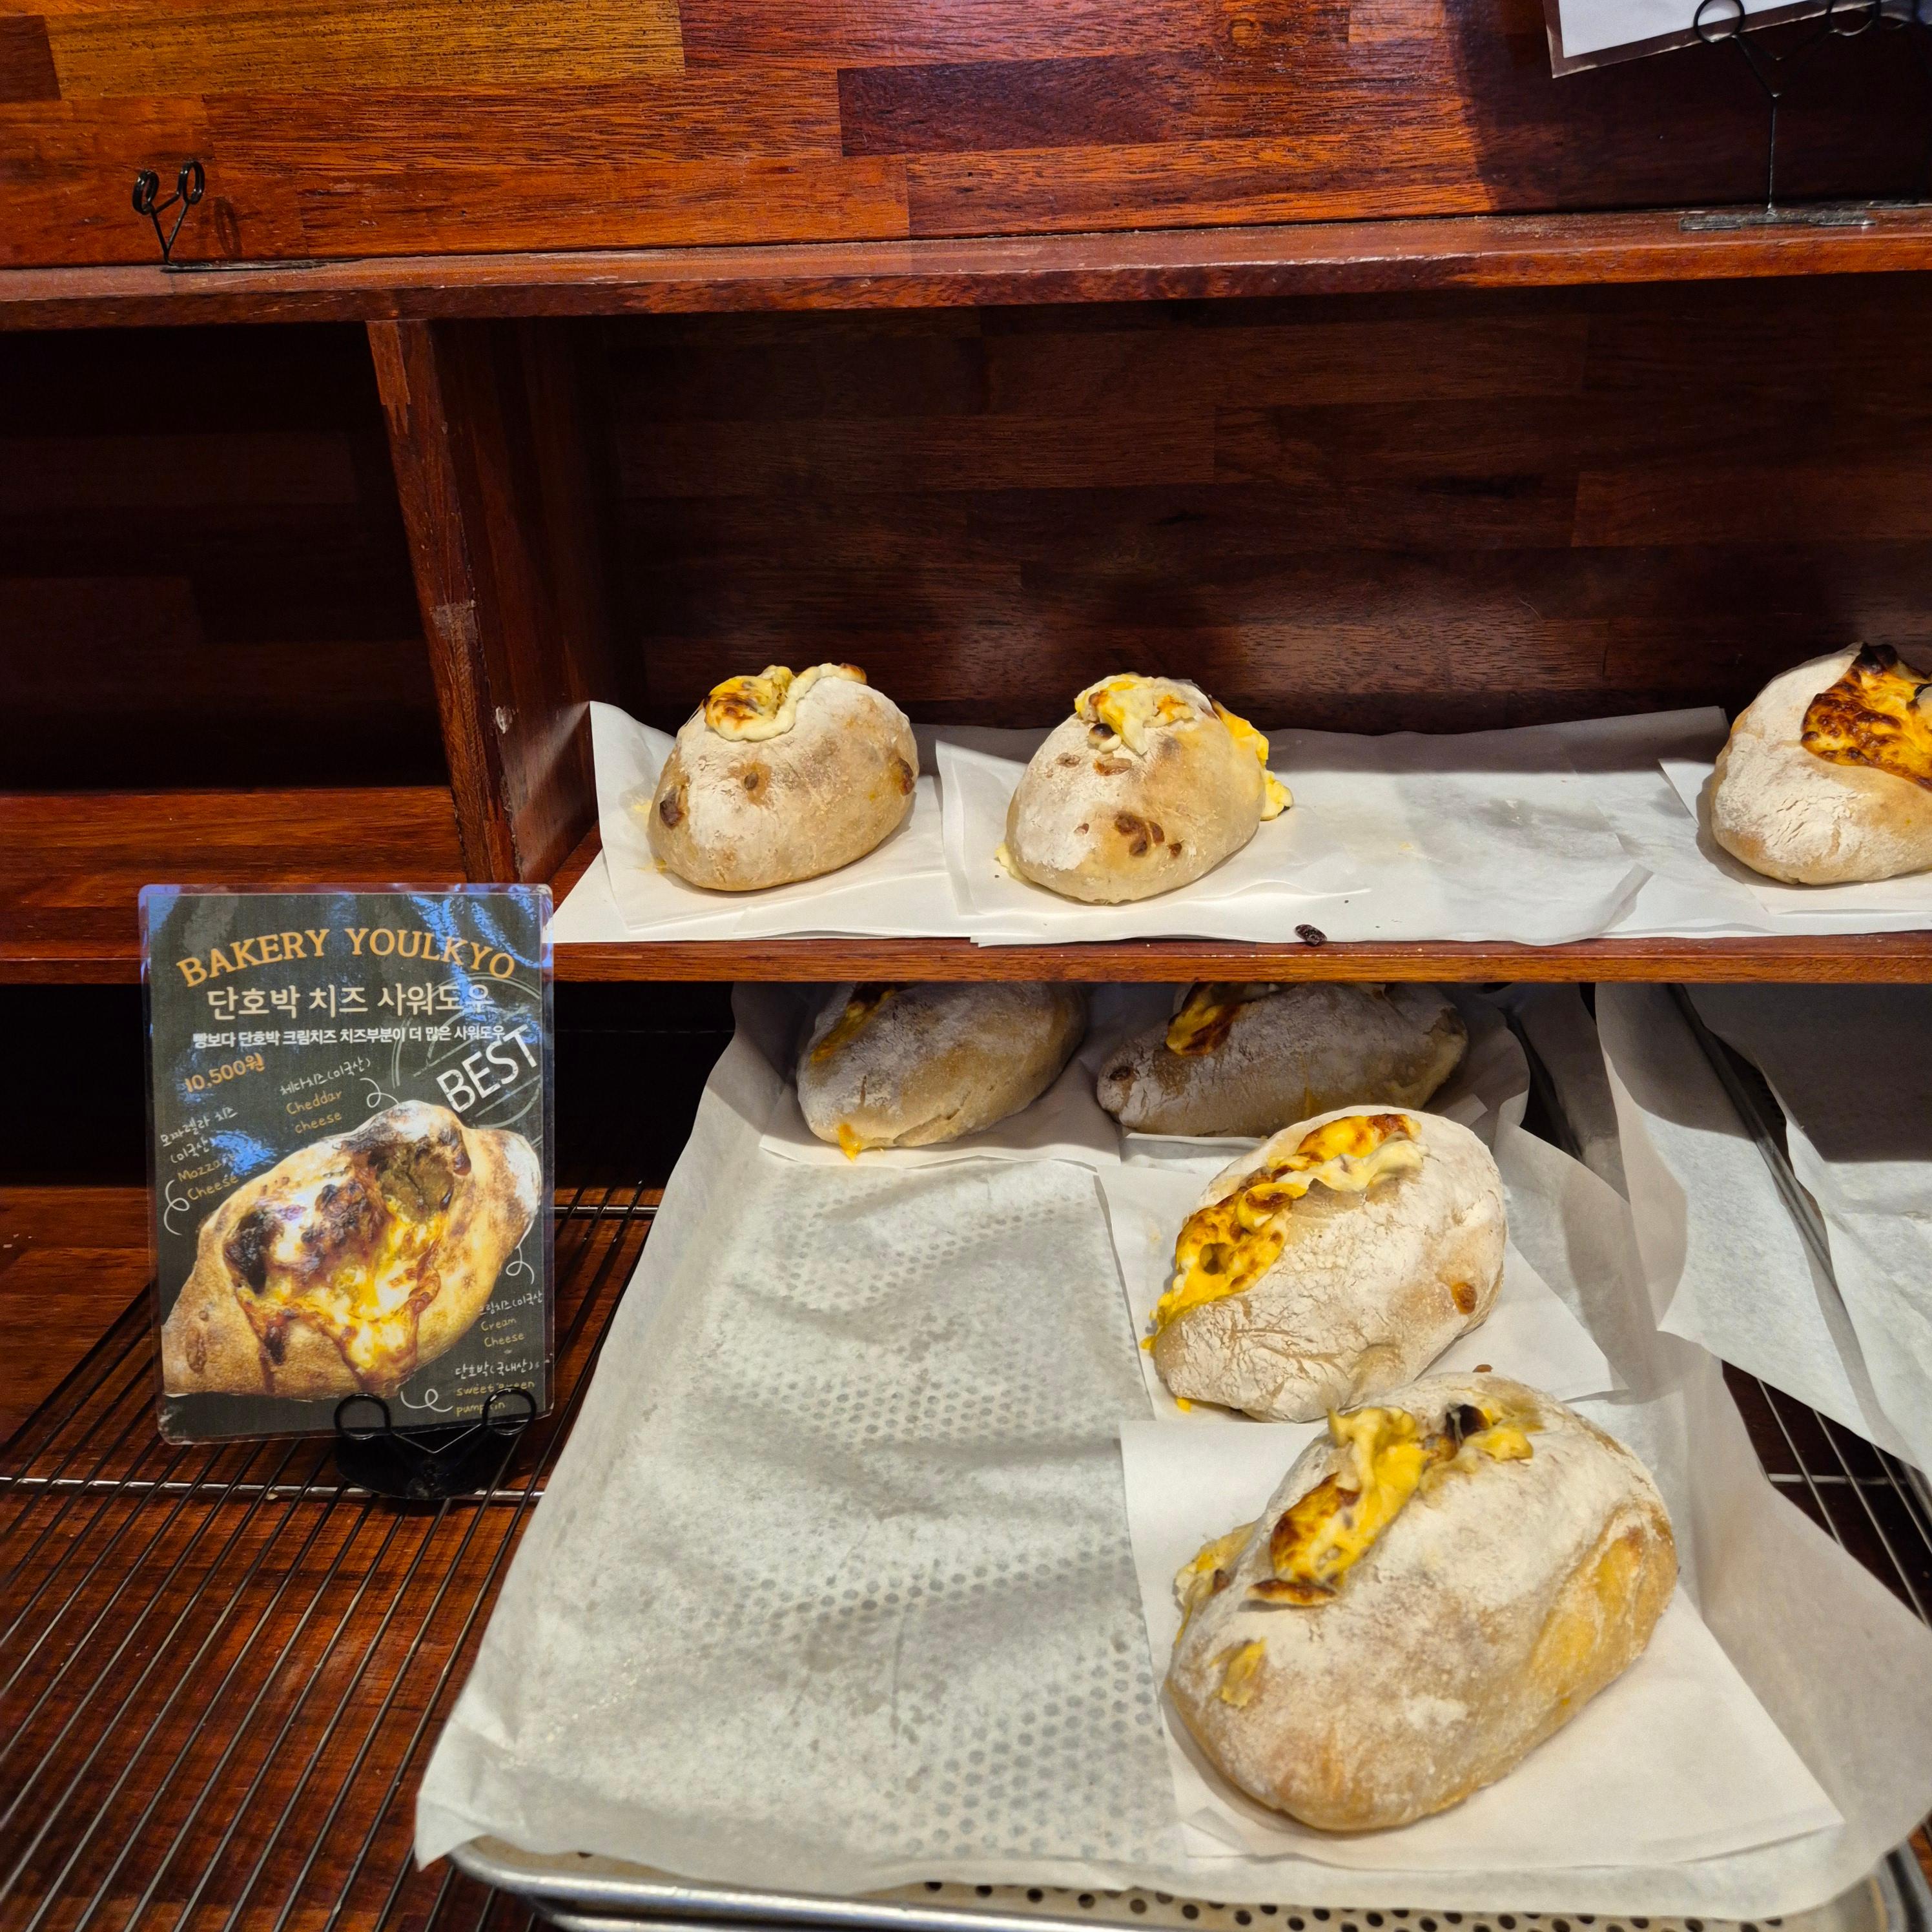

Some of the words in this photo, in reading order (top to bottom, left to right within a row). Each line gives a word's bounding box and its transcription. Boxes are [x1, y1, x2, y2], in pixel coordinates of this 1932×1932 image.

[176, 929, 330, 987] BAKERY
[344, 928, 515, 978] YOULKYO
[207, 985, 301, 1020] 단호박
[309, 985, 368, 1018] 치즈
[377, 982, 495, 1016] 사워도우
[192, 1031, 236, 1049] 빵보다
[238, 1031, 280, 1047] 단호박
[282, 1029, 338, 1046] 크림치즈
[340, 1027, 406, 1043] 치즈부분이
[409, 1027, 422, 1041] 더
[426, 1026, 451, 1042] 많은
[454, 1024, 506, 1041] 사워도우
[436, 1024, 538, 1114] BEST
[286, 1090, 342, 1115] Cheddar
[160, 1116, 211, 1147] 모짜렐라
[214, 1107, 238, 1122] 치즈
[187, 1175, 239, 1200] Cheese
[480, 1318, 517, 1331] Cream
[484, 1333, 525, 1348] Cheese
[457, 1384, 495, 1395] sweet
